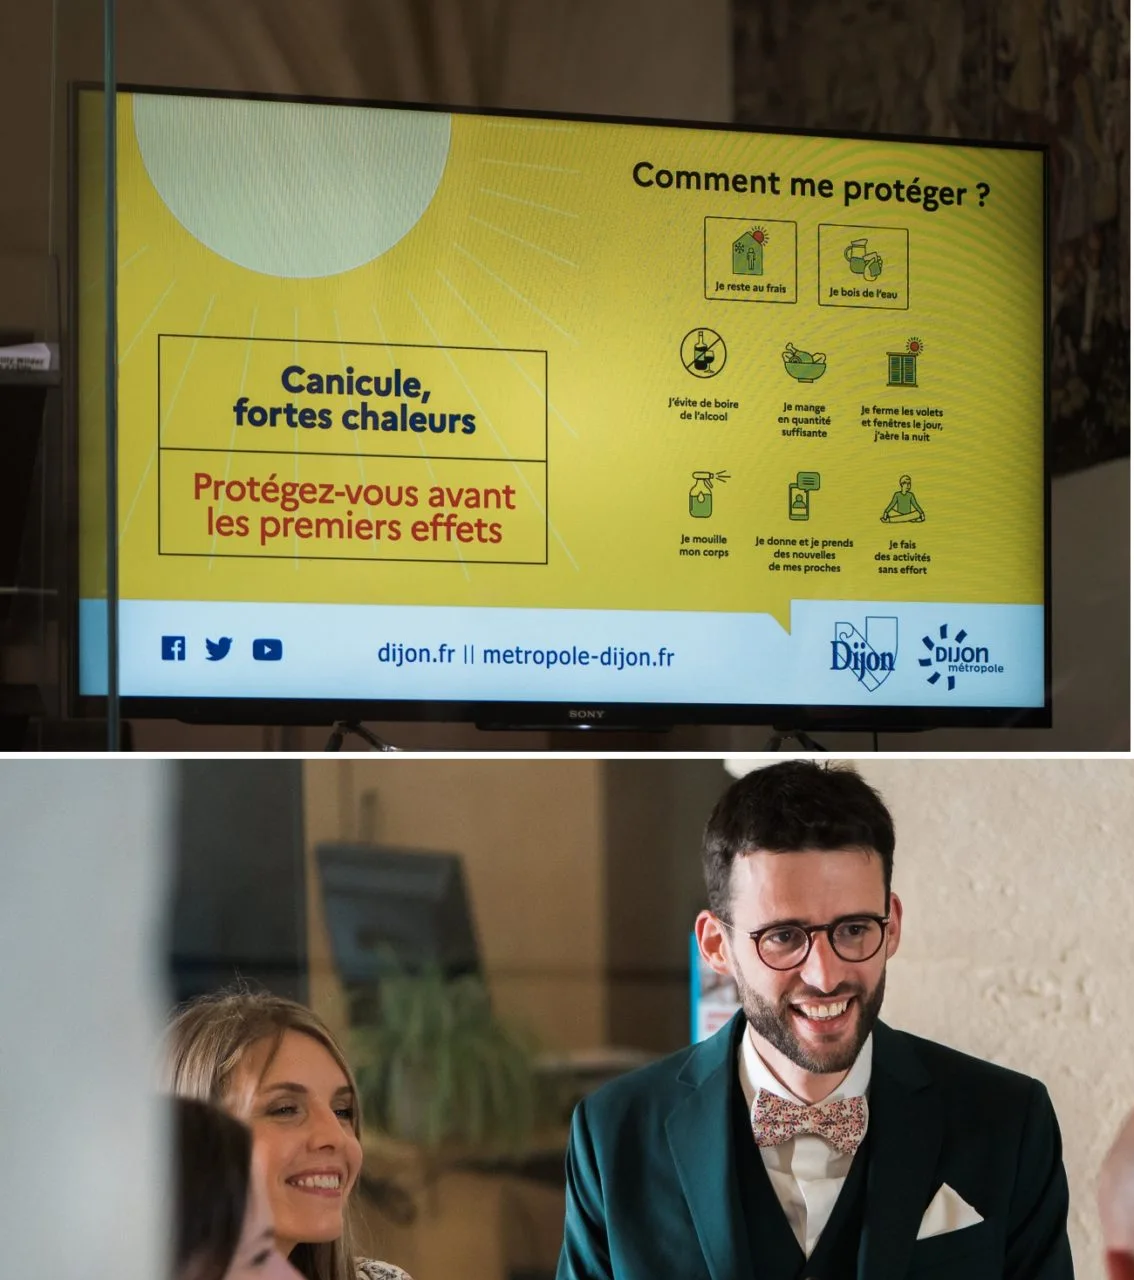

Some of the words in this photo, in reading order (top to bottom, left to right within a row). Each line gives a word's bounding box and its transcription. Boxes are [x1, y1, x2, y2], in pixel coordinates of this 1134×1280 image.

[632, 161, 781, 195] Comment
[790, 175, 834, 198] me
[844, 177, 967, 212] protéger
[976, 182, 991, 207] ?
[715, 281, 725, 292] Je
[727, 283, 750, 292] reste
[766, 283, 786, 293] frais
[829, 287, 839, 297] Je
[841, 287, 860, 298] bois
[862, 289, 874, 298] de
[877, 289, 898, 299] l'eau
[281, 365, 431, 404] Canicule,
[668, 397, 697, 408] J'évite
[700, 398, 711, 408] de
[714, 398, 739, 409] boire
[783, 402, 793, 413] Je
[795, 404, 826, 415] mange
[233, 397, 333, 430] fortes
[342, 401, 477, 435] chaleurs
[680, 410, 692, 420] de
[694, 411, 728, 421] l'alcool
[861, 405, 870, 416] Je
[872, 405, 899, 416] ferme
[901, 406, 914, 416] les
[916, 407, 943, 417] volets
[777, 416, 790, 424] en
[792, 416, 831, 426] quantité
[861, 419, 871, 427] et
[873, 418, 911, 428] fenêtres
[913, 419, 921, 429] le
[922, 419, 943, 431] jour,
[781, 428, 827, 438] suffisante
[874, 430, 900, 442] j'aère
[901, 431, 910, 441] la
[912, 432, 930, 442] nuit
[193, 472, 419, 512] Protégez-vous
[428, 484, 516, 510] avant
[207, 506, 250, 538] les
[260, 510, 401, 546] premiers
[411, 513, 503, 544] effets
[680, 534, 690, 545] Je
[692, 535, 727, 545] mouille
[755, 536, 765, 546] Je
[767, 536, 797, 547] donne
[799, 538, 809, 547] et
[810, 537, 820, 549] je
[822, 538, 854, 549] prends
[889, 540, 898, 550] Je
[900, 540, 916, 549] fais
[679, 548, 701, 557] mon
[703, 549, 729, 559] corps
[773, 549, 790, 559] des
[792, 550, 836, 560] nouvelles
[874, 552, 891, 561] des
[892, 552, 931, 563] activités
[768, 562, 781, 571] de
[783, 564, 802, 572] mes
[804, 563, 841, 574] proches
[878, 565, 898, 574] sans
[900, 565, 928, 575] effort
[377, 643, 455, 666] dijon.fr
[483, 645, 675, 670] metropole-dijon.fr
[830, 640, 896, 682] Dijon
[948, 664, 1004, 674] métropole
[568, 710, 605, 719] SONY
